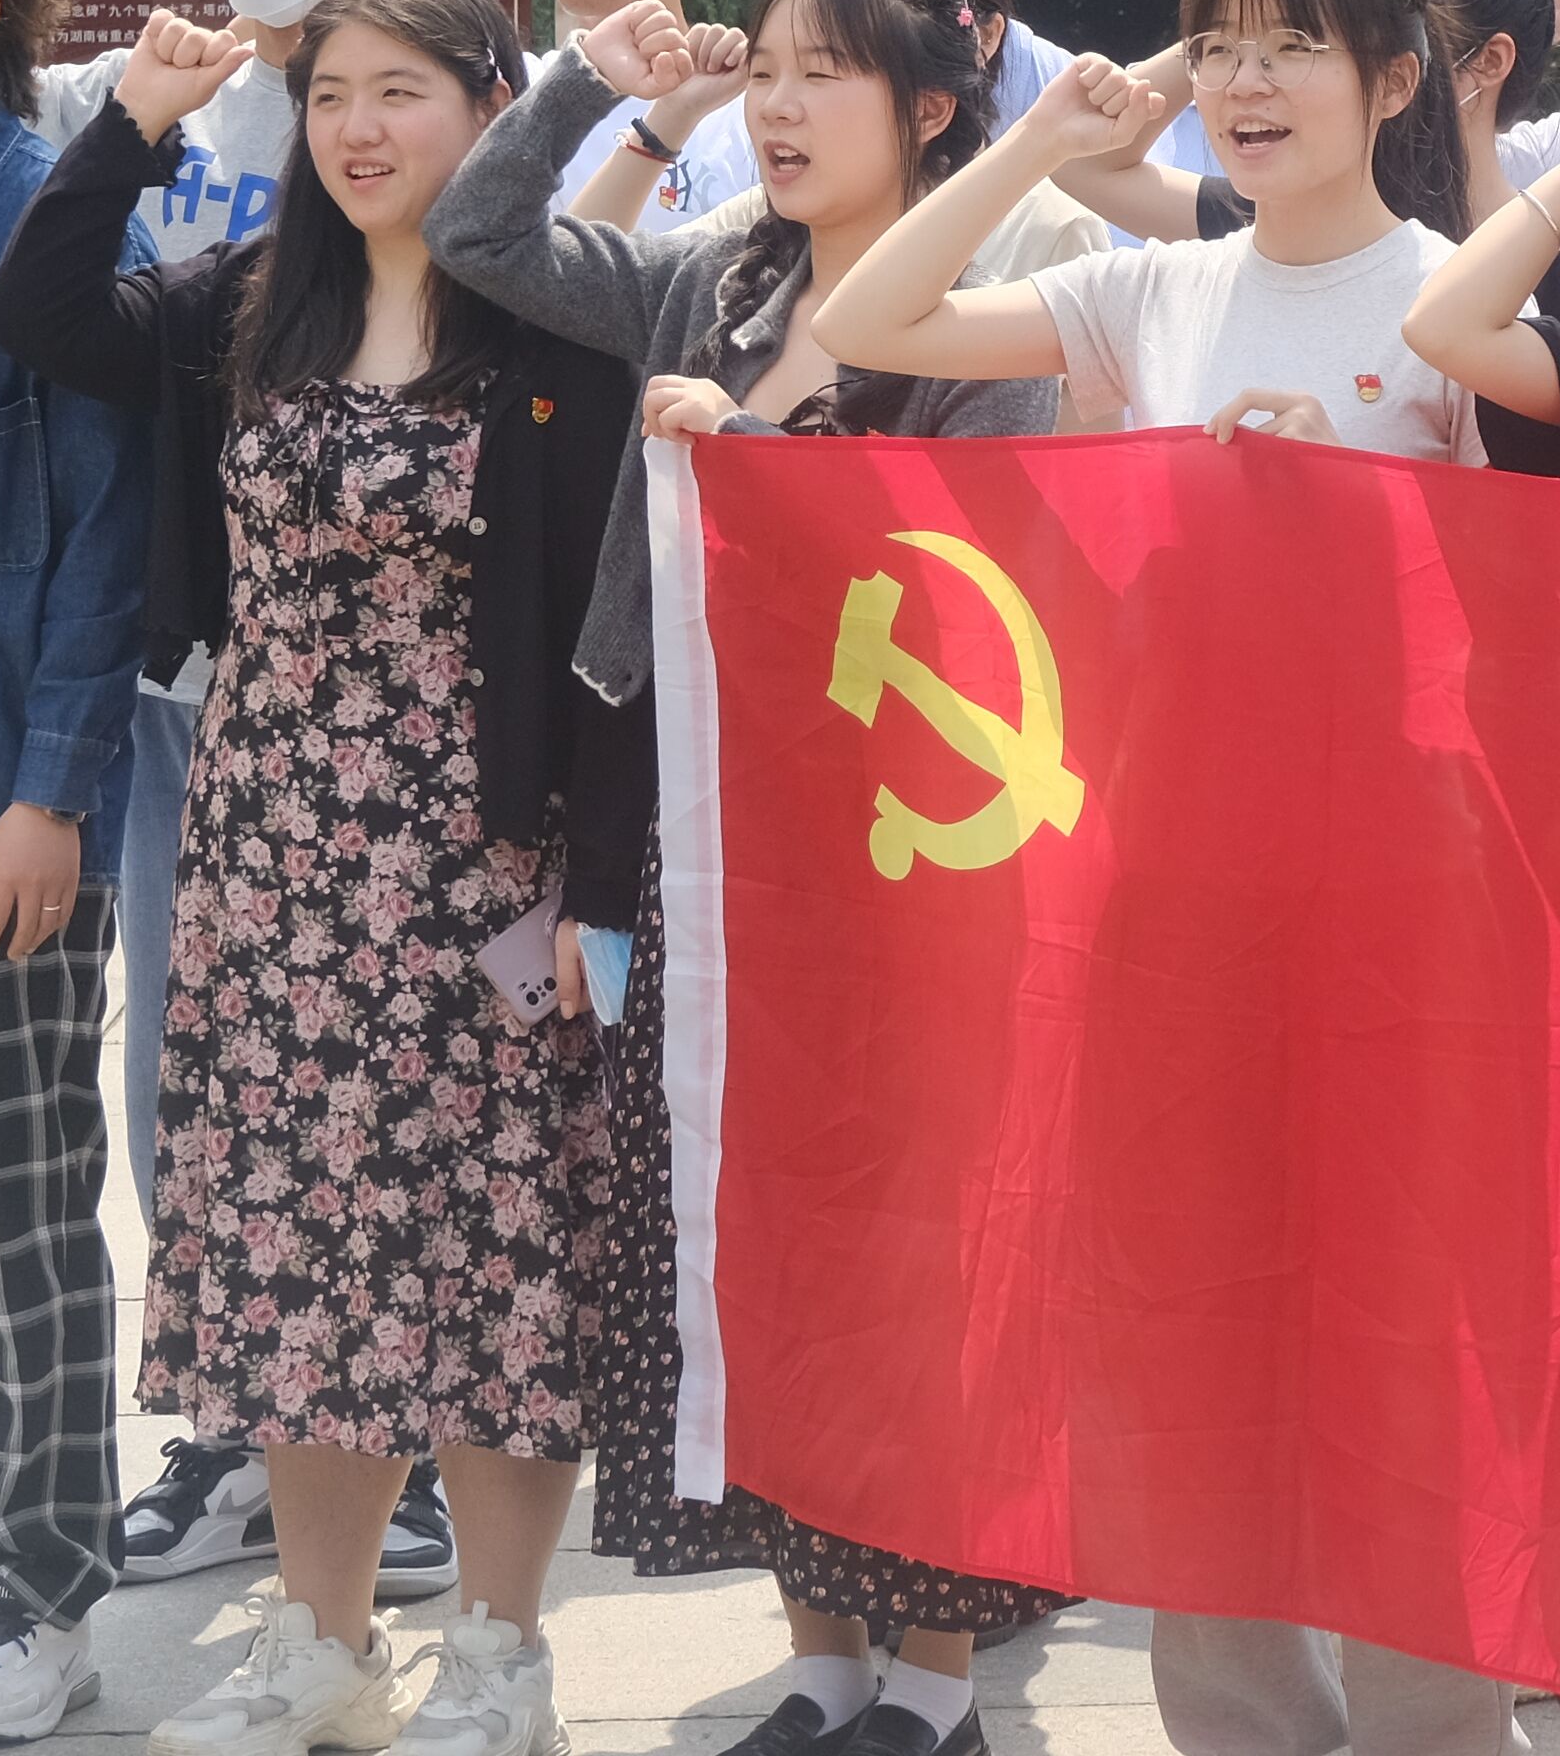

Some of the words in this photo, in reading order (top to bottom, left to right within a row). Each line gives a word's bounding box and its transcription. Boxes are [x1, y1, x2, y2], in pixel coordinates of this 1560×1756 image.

[57, 29, 141, 43] 为湖南省重点
